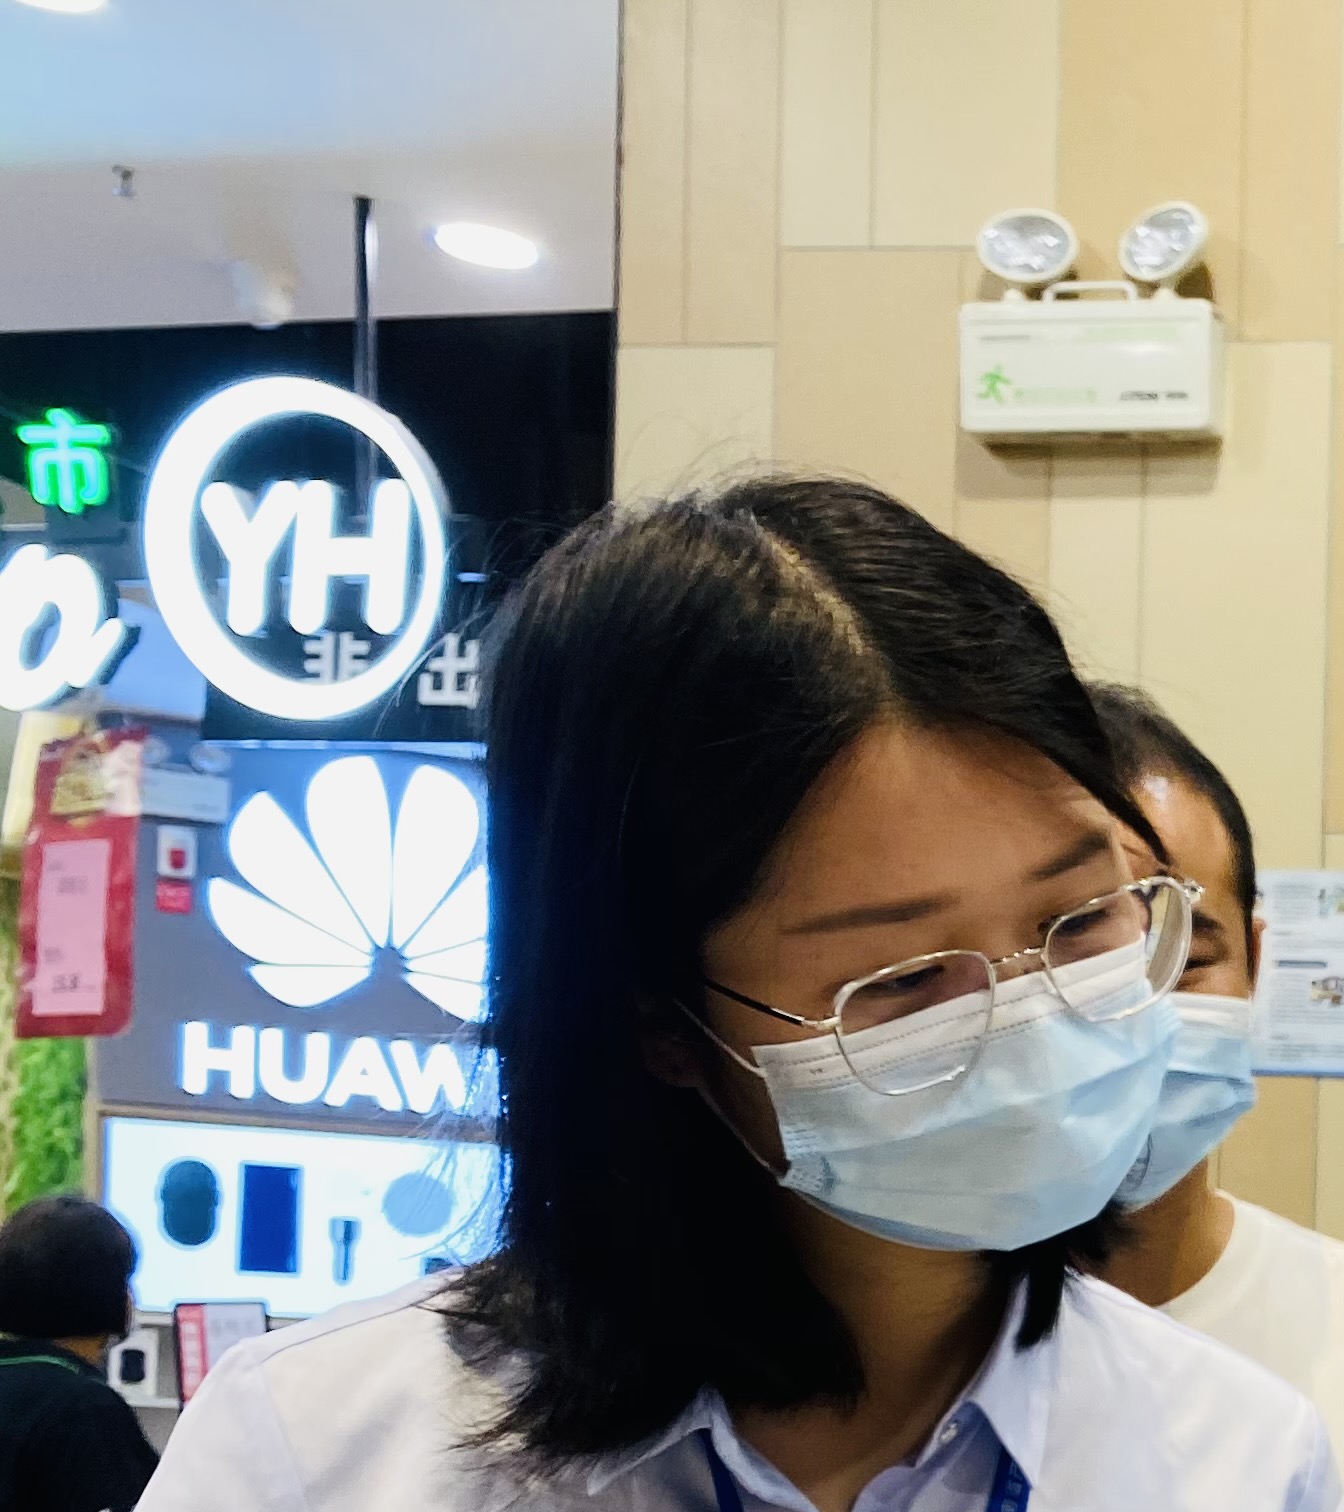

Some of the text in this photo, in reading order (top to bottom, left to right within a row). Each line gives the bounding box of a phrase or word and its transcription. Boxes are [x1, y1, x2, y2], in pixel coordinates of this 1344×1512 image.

[16, 408, 113, 516] 市
[200, 478, 412, 638] YH
[180, 1020, 490, 1115] HUAW
